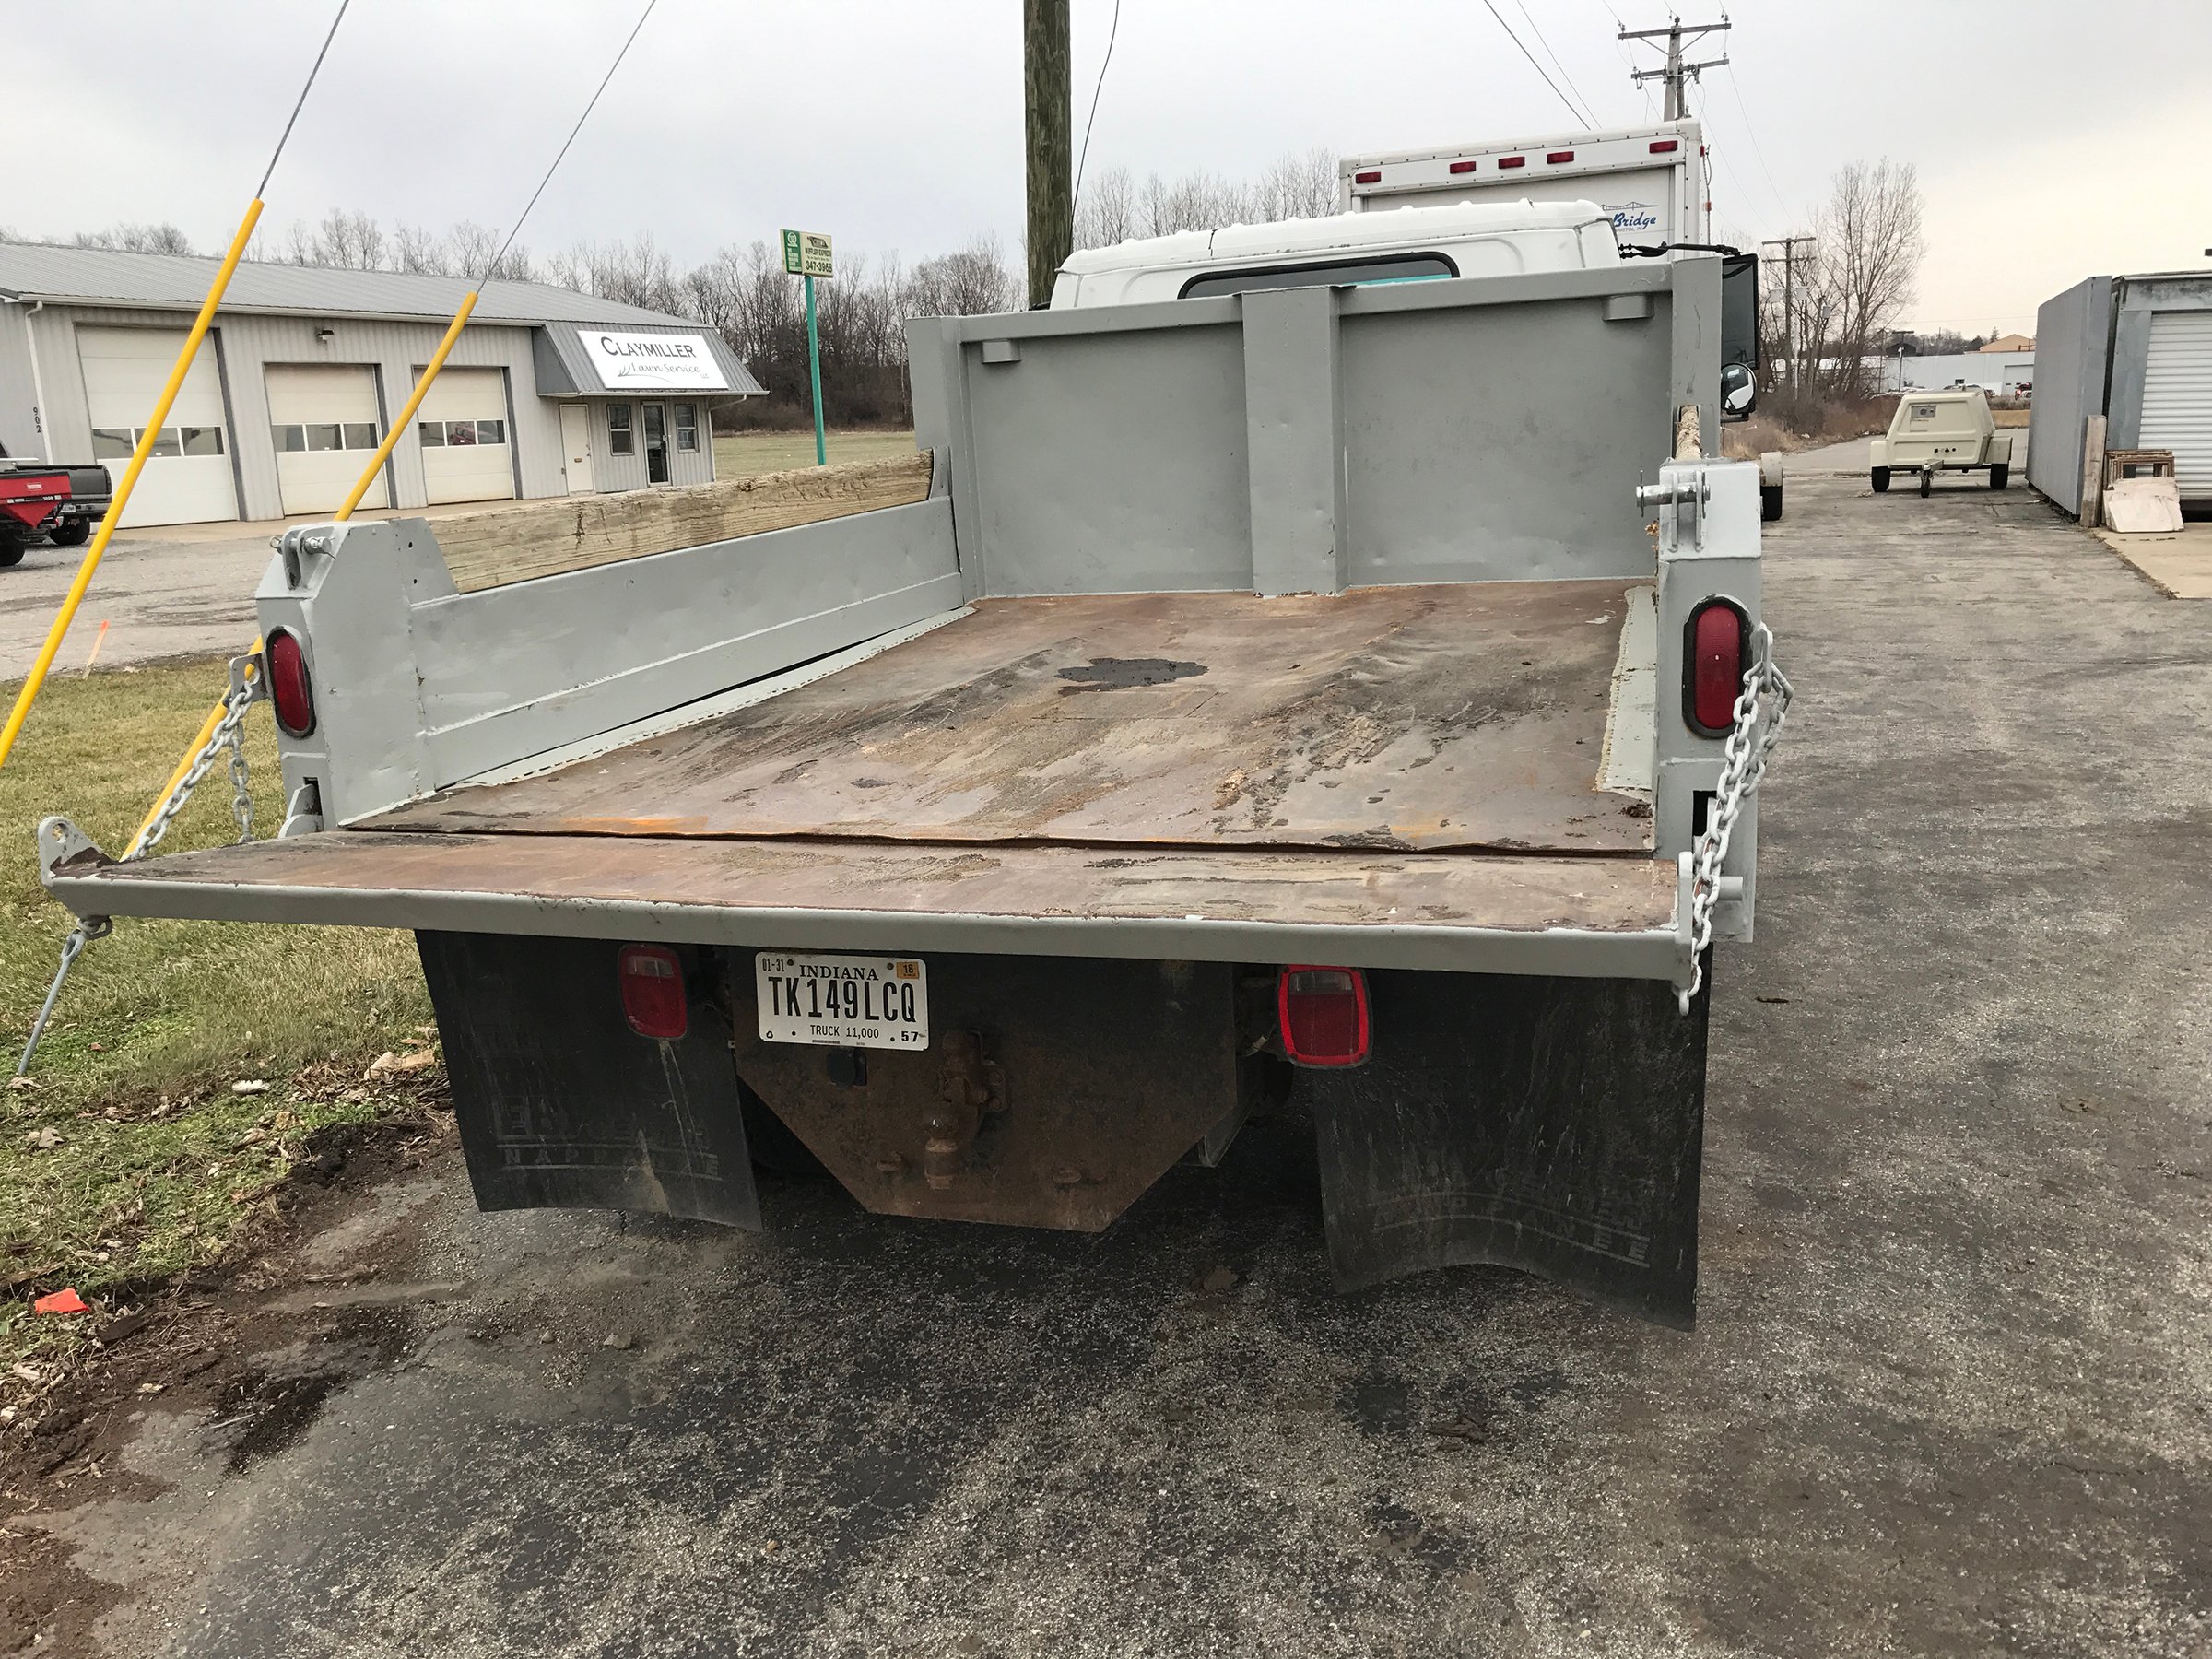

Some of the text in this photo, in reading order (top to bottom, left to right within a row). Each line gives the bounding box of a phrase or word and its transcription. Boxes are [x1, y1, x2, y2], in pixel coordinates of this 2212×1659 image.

[1614, 211, 1656, 229] Bridge
[601, 336, 697, 358] CLAYMILLER
[631, 362, 700, 373] Lawn Service
[33, 406, 41, 433] 902
[762, 958, 785, 972] 01-31
[800, 964, 879, 981] INDIANA
[902, 963, 914, 973] 18
[768, 976, 917, 1023] TK149LCQ
[810, 1024, 879, 1039] TRUCK 11,000
[900, 1030, 919, 1042] 57
